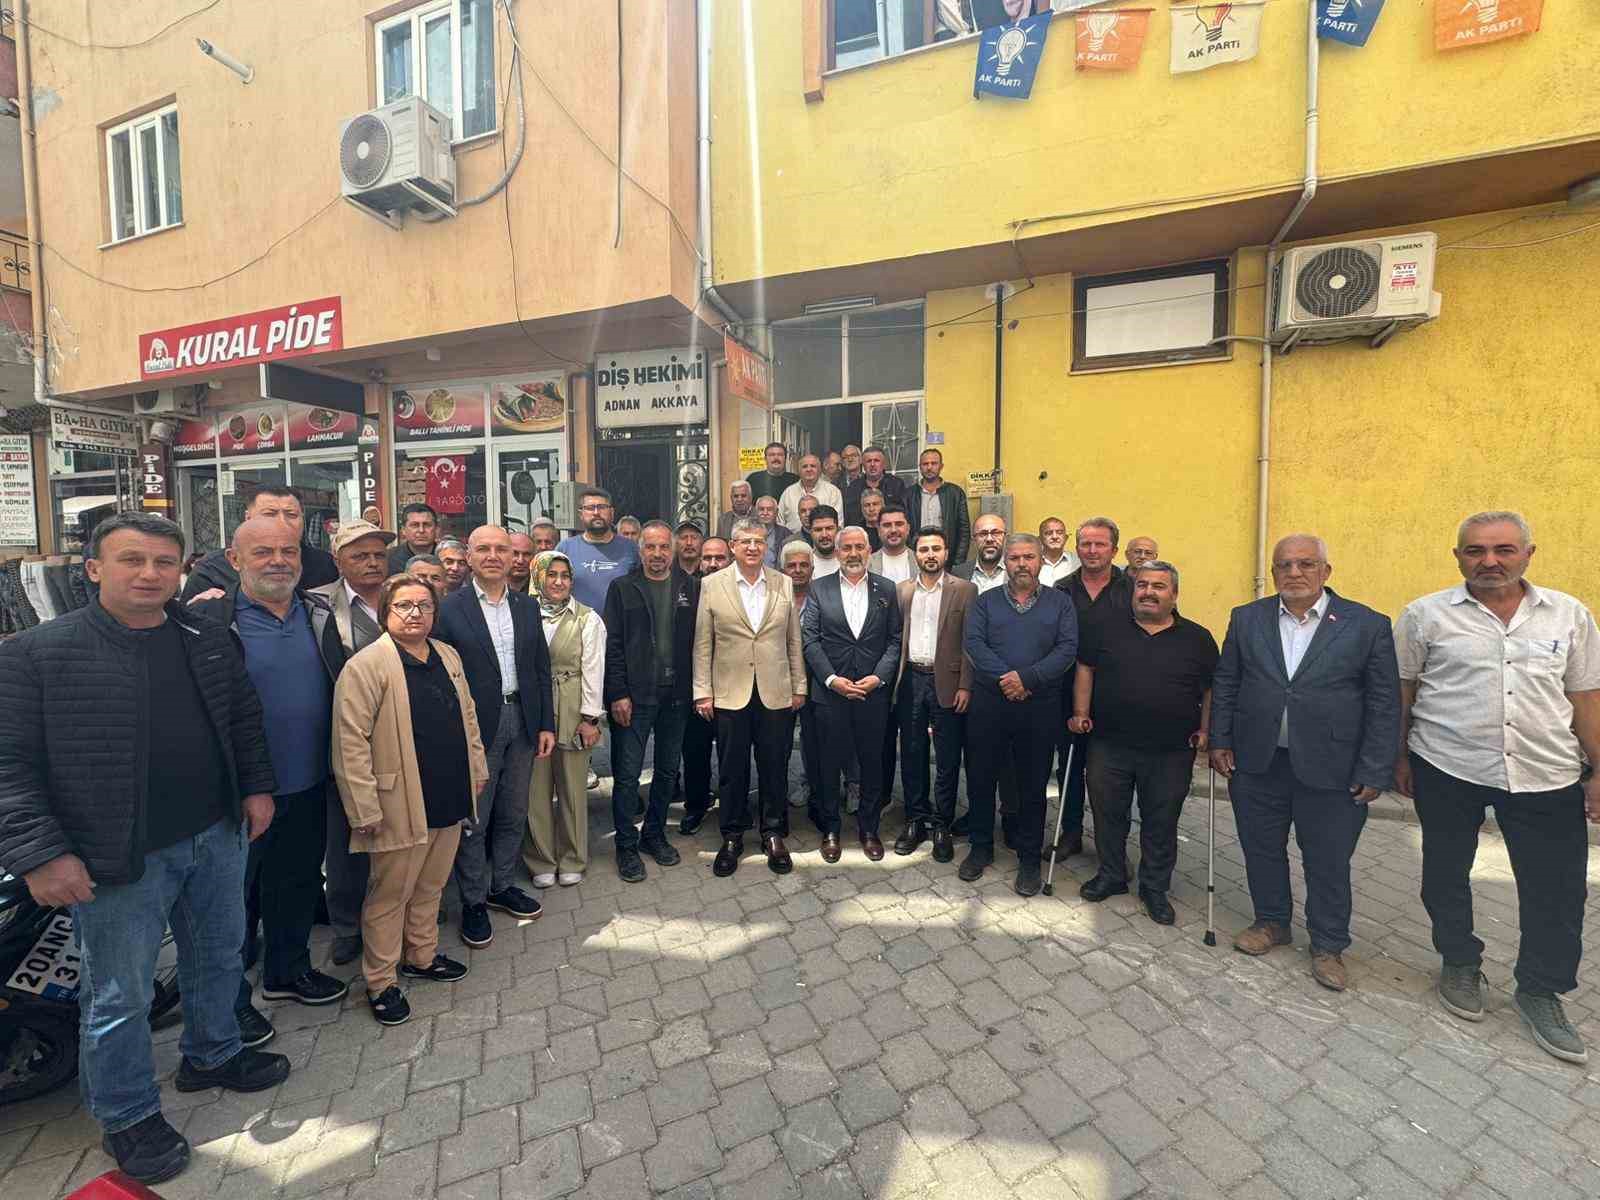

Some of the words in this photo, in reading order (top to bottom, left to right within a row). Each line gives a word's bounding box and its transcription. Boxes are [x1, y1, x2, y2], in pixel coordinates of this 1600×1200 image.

[1323, 18, 1358, 33] PARTİ
[1455, 28, 1475, 41] AK
[1479, 17, 1524, 36] PARTİ
[1076, 53, 1086, 62] K
[1187, 47, 1204, 60] AK
[1207, 39, 1241, 54] PARTİ
[978, 73, 993, 83] AK
[993, 77, 1022, 88] PARTİ
[176, 324, 261, 369] KURAL
[266, 306, 336, 354] PİDE
[598, 360, 630, 391] DİŞ
[633, 353, 704, 384] HEKİMİ
[604, 398, 641, 412] ADNAN
[651, 395, 699, 409] AKKAYA
